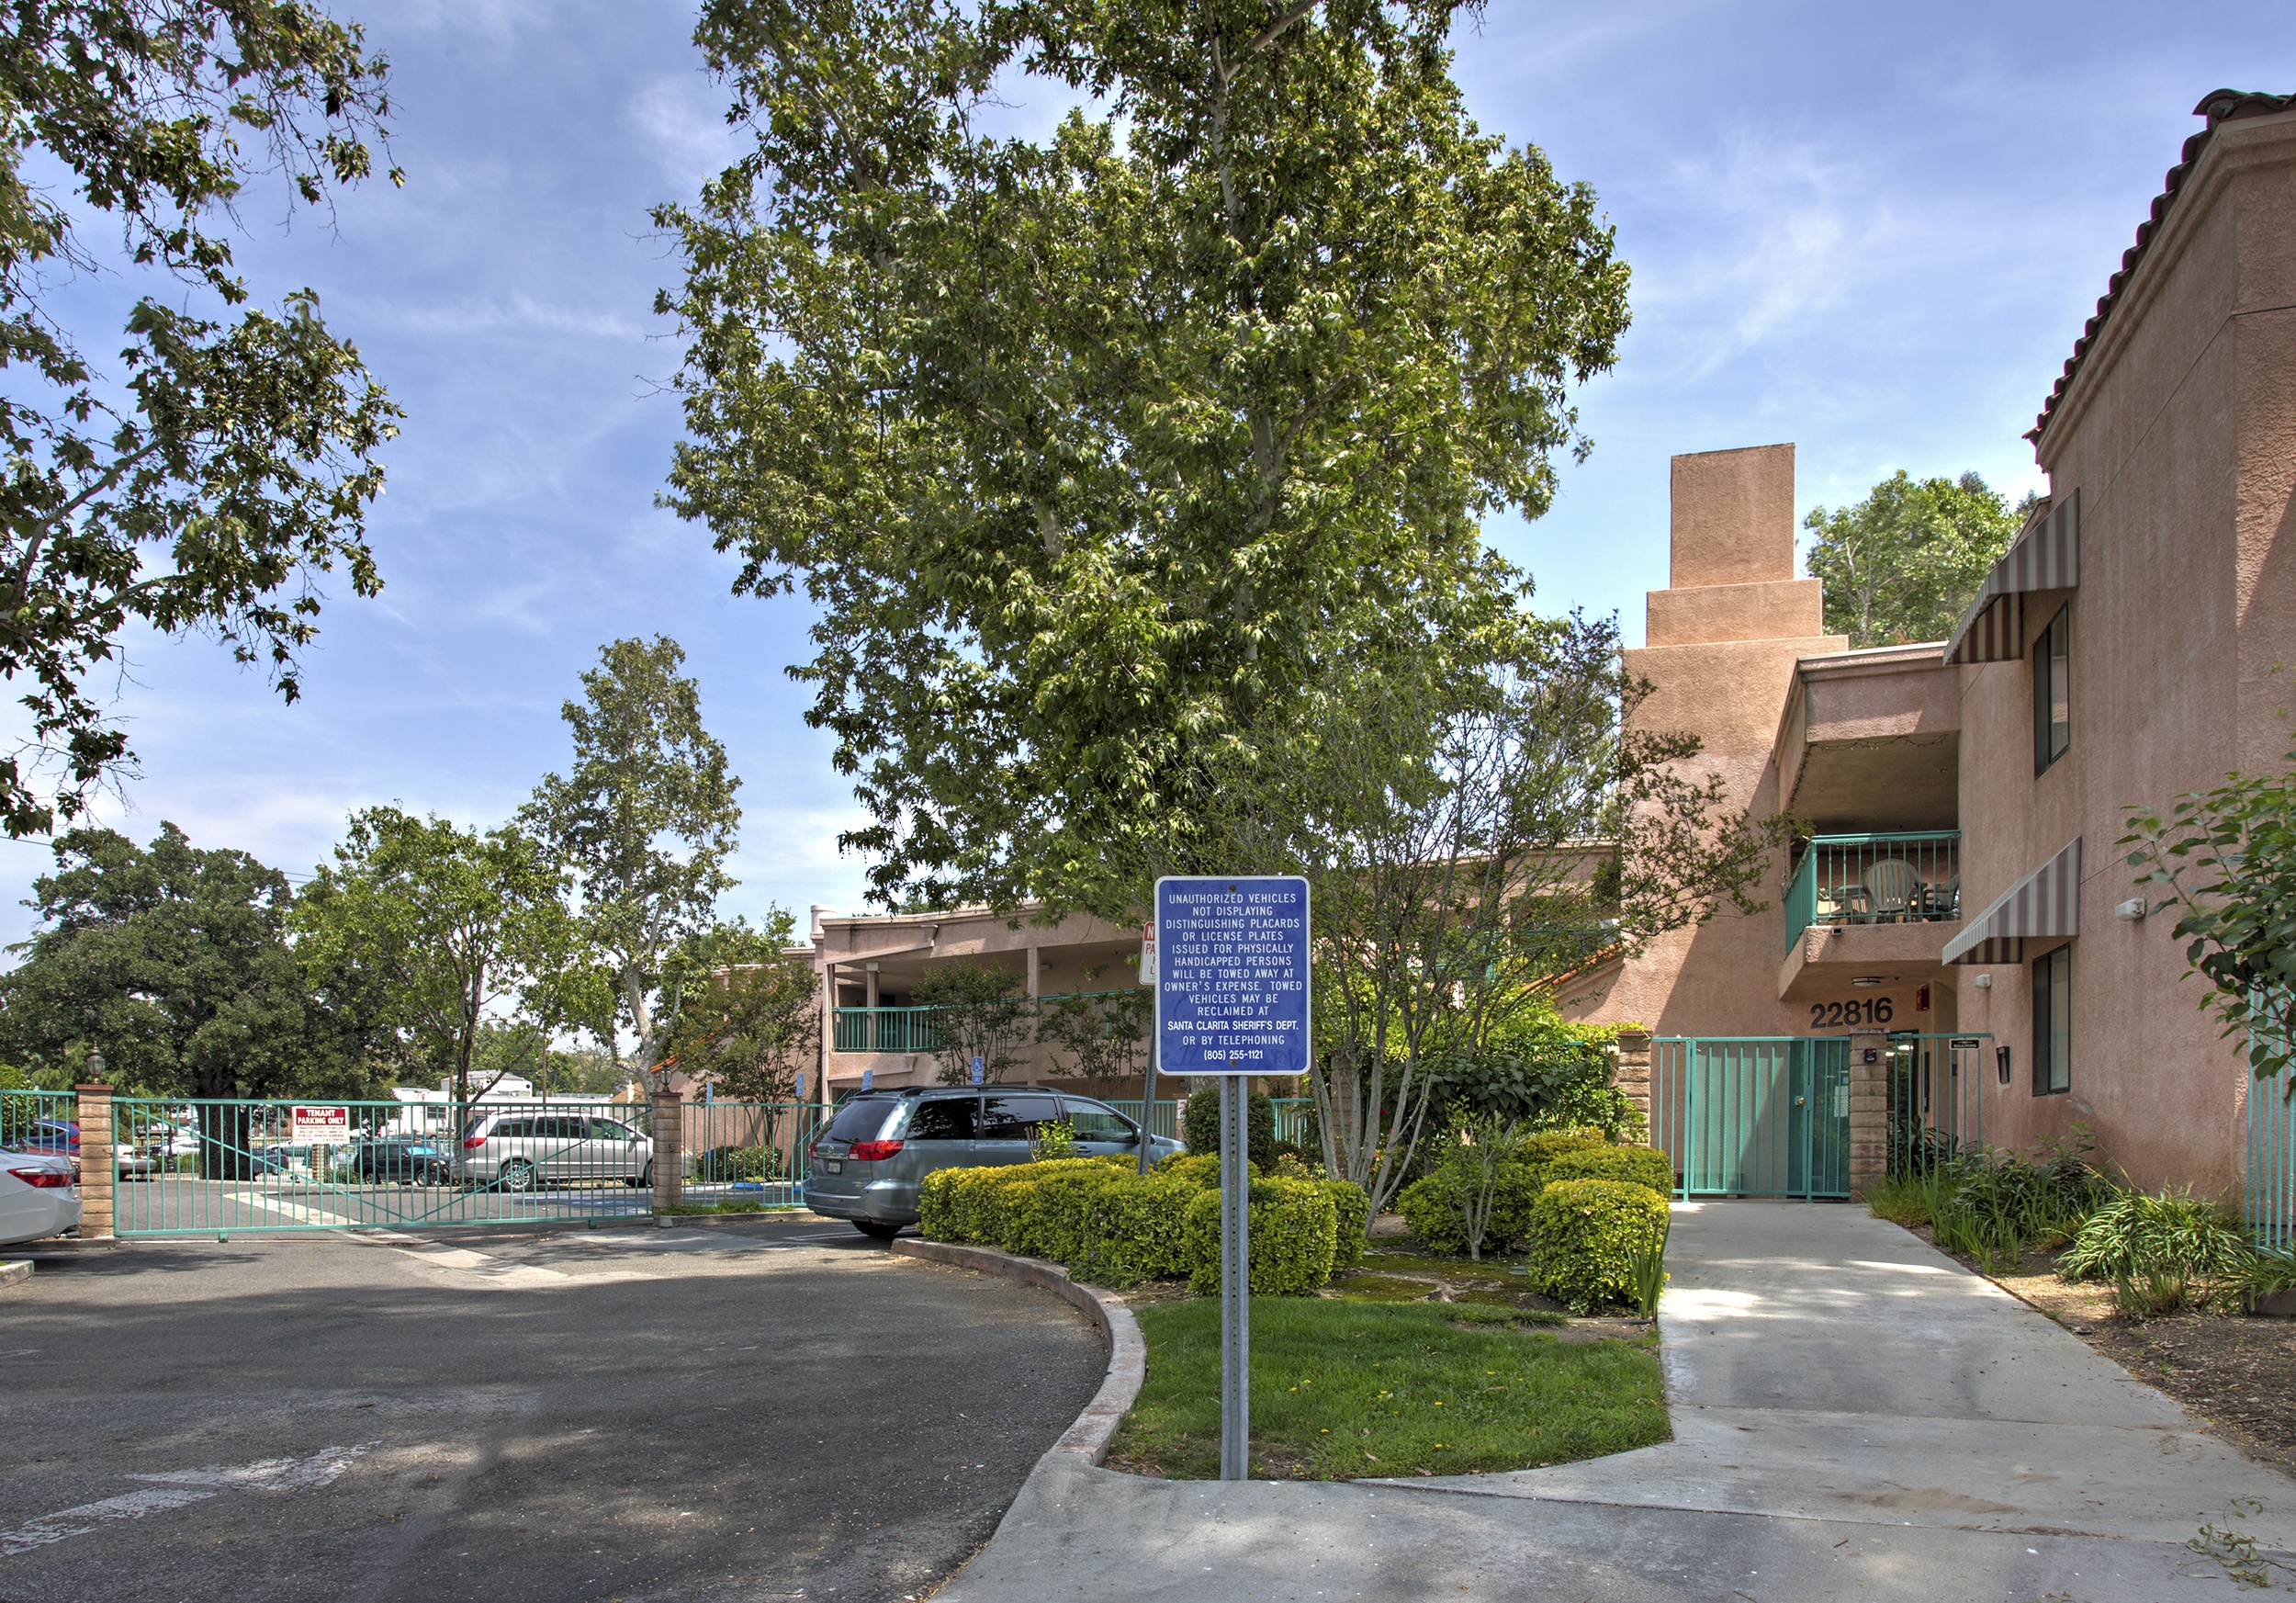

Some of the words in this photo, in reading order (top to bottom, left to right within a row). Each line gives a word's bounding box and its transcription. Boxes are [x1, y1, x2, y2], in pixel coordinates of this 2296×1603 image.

[1170, 894, 1243, 904] UNAUTHORIZED
[1249, 894, 1296, 903] VEHICLES
[1193, 907, 1210, 916] NOT
[1217, 907, 1272, 916] DISPLAYING
[1166, 919, 1244, 929] DISTINGUISHING
[1251, 919, 1299, 928] PLACARDS
[1183, 932, 1195, 941] OR
[1202, 931, 1242, 941] LICENSE
[1249, 931, 1283, 941] PLATES
[1173, 944, 1208, 954] ISSUED
[1214, 944, 1232, 954] FOR
[1238, 943, 1293, 953] PHYSICALLY
[1176, 956, 1240, 965] HANDICAPPED
[1247, 956, 1291, 965] PERSONS
[1173, 970, 1194, 978] WILL
[1200, 969, 1211, 978] BE
[1219, 969, 1249, 978] TOWED
[1255, 969, 1278, 977] AWAY
[1284, 969, 1293, 977] AT
[1165, 981, 1210, 991] OWNER'S
[1216, 981, 1262, 990] EXPENSE.
[1271, 981, 1301, 990] TOWED
[1189, 994, 1235, 1003] VEHICLES
[1243, 994, 1260, 1003] MAY
[1266, 994, 1277, 1002] BE
[1198, 1007, 1253, 1016] RECLAIMED
[1258, 1007, 1268, 1015] AT
[1810, 997, 1893, 1029] 22816
[1168, 1021, 1193, 1031] SANTA
[1197, 1021, 1229, 1030] CLARITA
[1232, 1021, 1272, 1030] SHERIFF'S
[1277, 1021, 1299, 1030] DEPT.
[1183, 1036, 1195, 1044] OR
[1202, 1036, 1213, 1044] BY
[1219, 1035, 1284, 1044] TELEPHONING
[1204, 1050, 1225, 1060] (805)
[1230, 1050, 1263, 1059] 255-1121
[306, 1109, 335, 1117] TENANT
